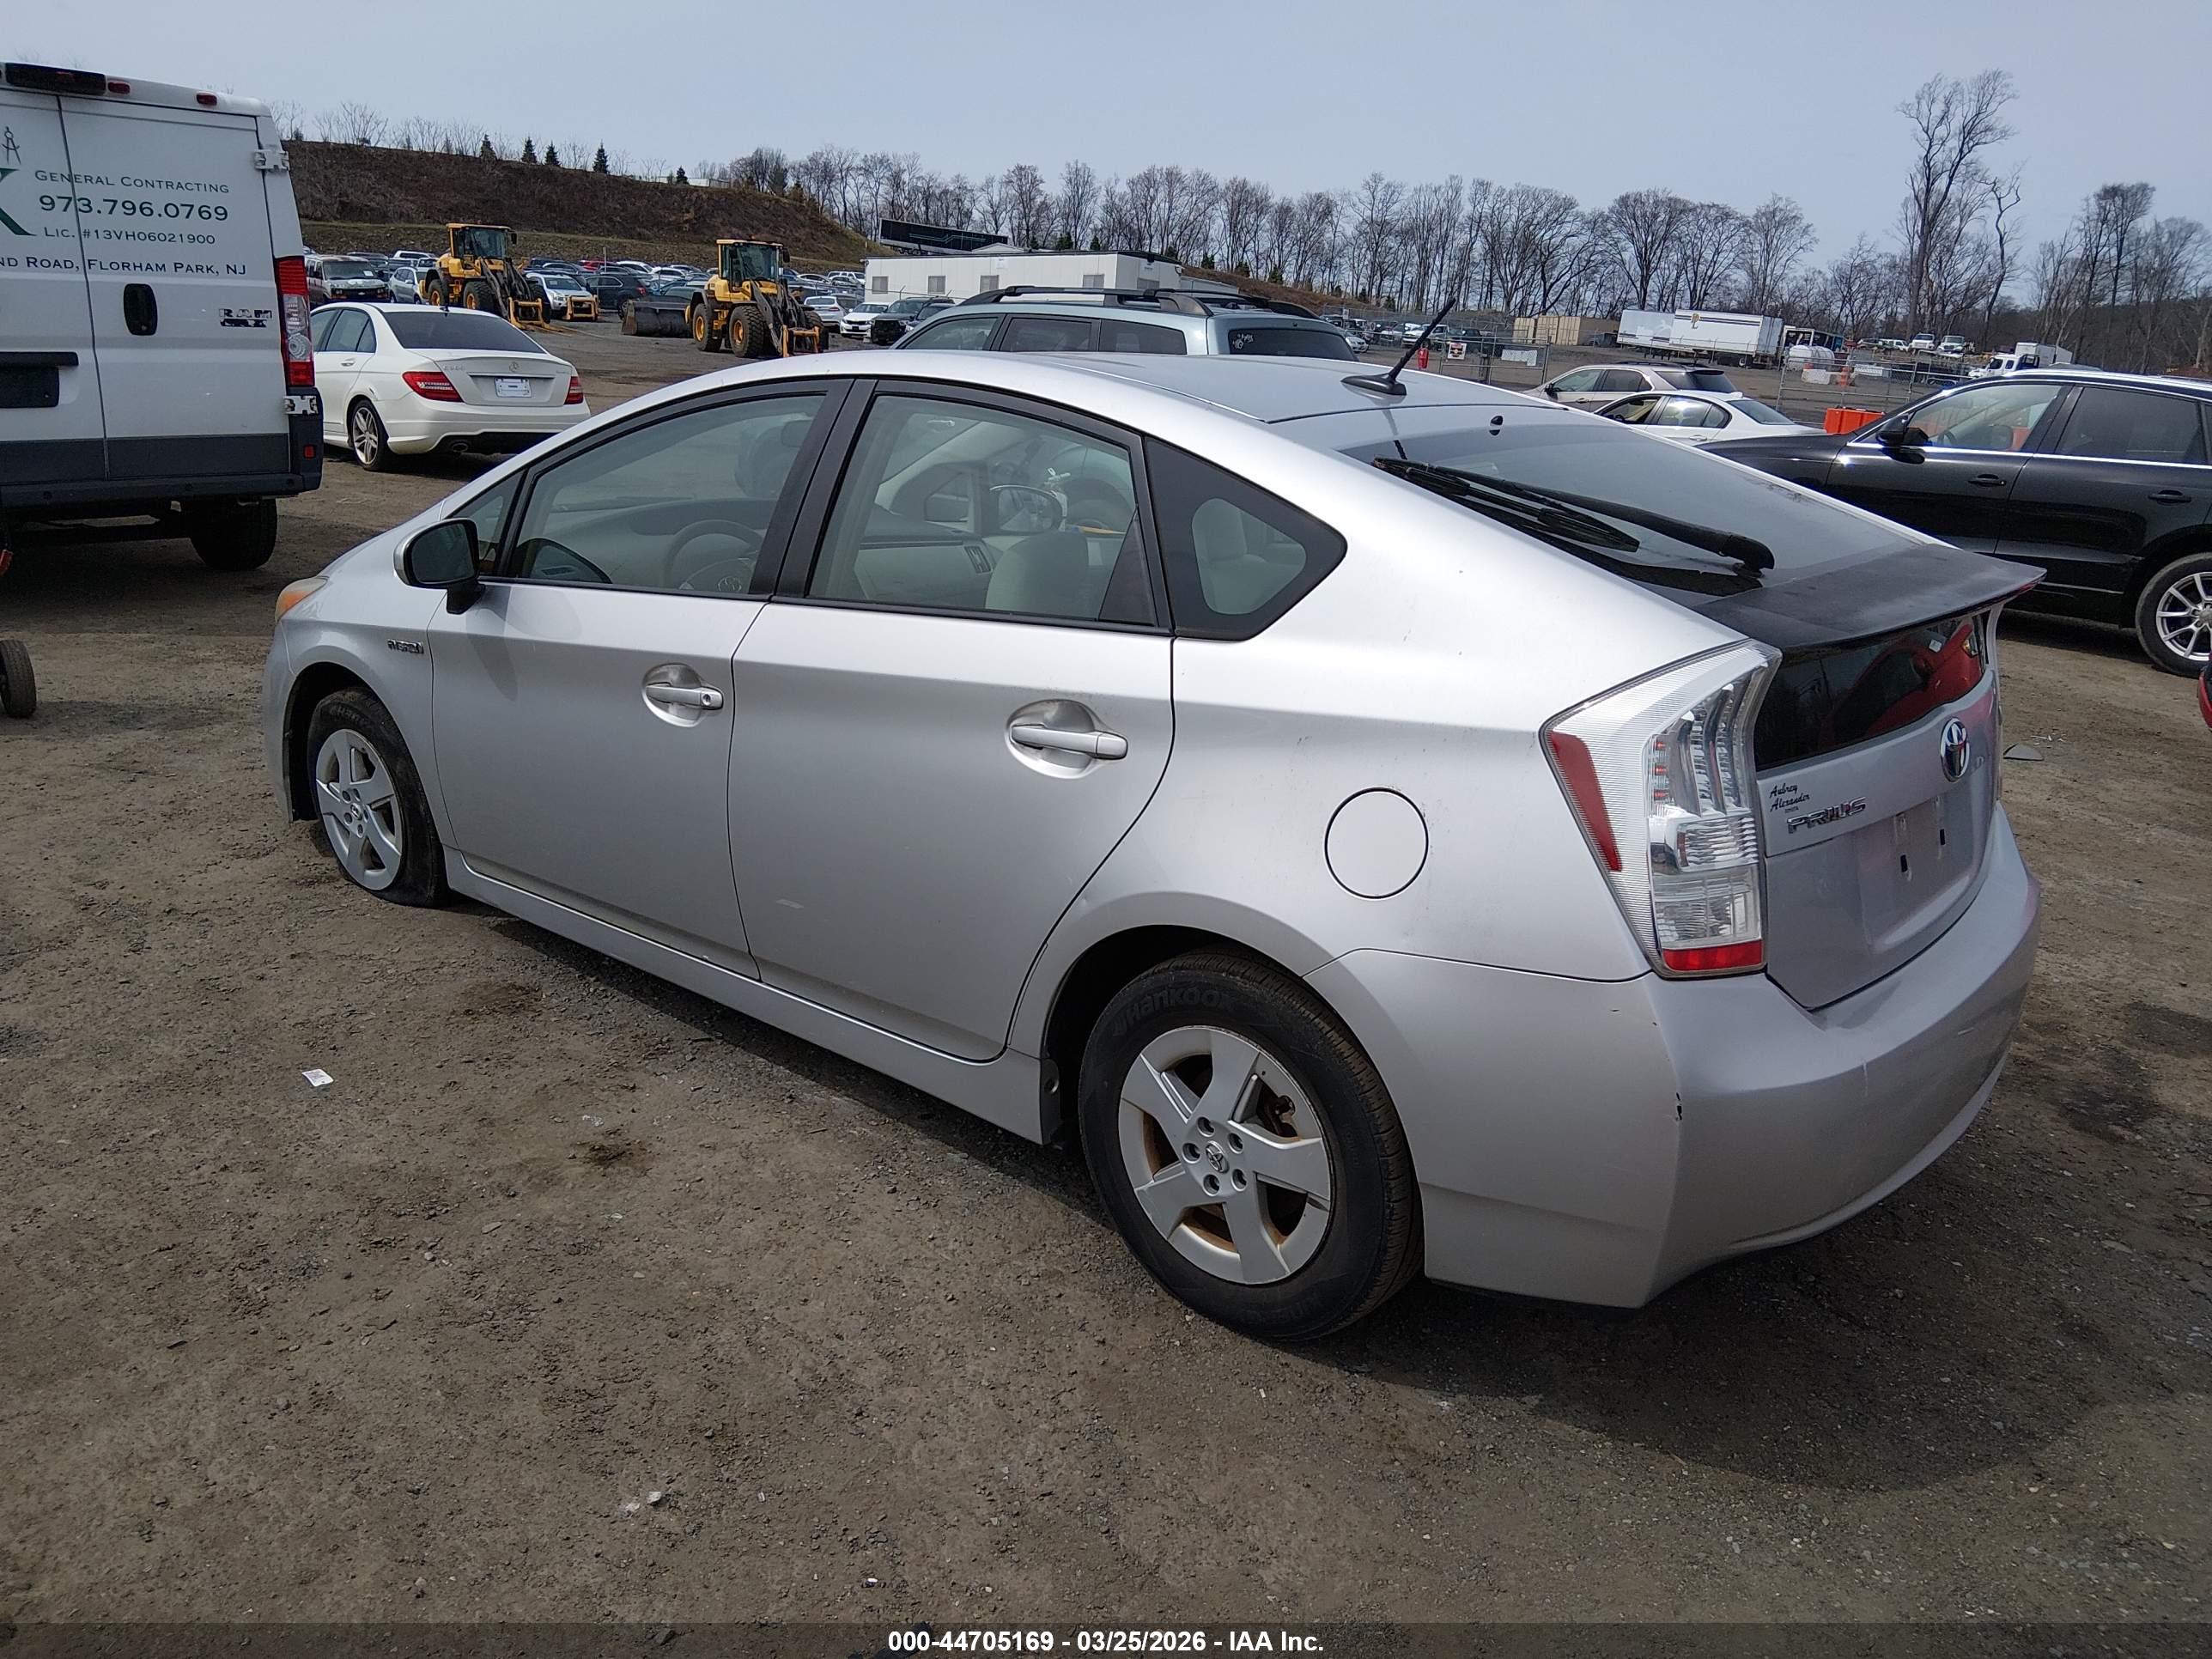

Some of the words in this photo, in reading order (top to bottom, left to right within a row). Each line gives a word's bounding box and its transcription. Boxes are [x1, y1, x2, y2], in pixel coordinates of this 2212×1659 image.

[34, 170, 115, 185] GENERAL
[120, 176, 229, 193] CONTRACTING
[39, 194, 228, 221] 973.796.0769
[82, 228, 216, 244] #13VH06021900
[26, 256, 80, 272] ROAD,
[87, 258, 167, 272] FLORHAM
[173, 262, 219, 276] PARK,
[226, 264, 246, 275] NJ
[1787, 797, 1866, 834] PRIUS
